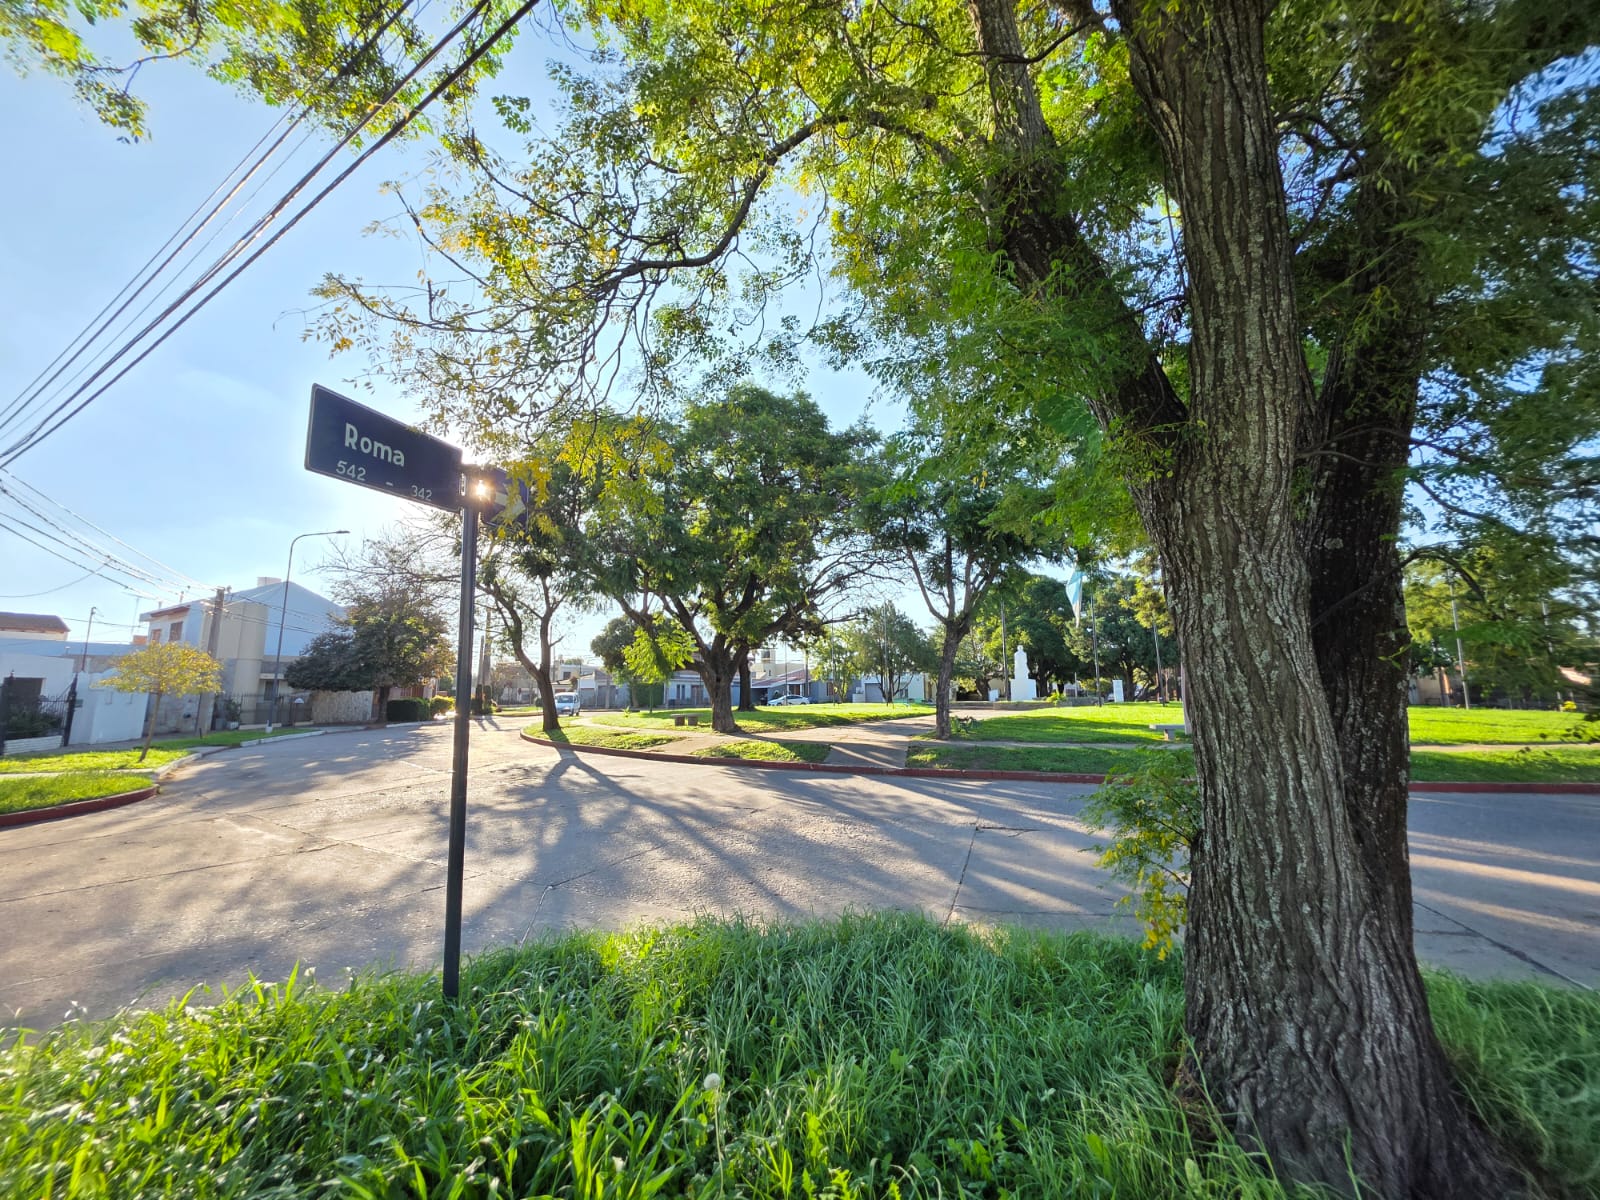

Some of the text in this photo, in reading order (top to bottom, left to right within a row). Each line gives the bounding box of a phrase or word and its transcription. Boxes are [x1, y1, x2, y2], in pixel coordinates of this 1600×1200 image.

[344, 422, 405, 467] Roma
[336, 460, 366, 481] 542
[411, 485, 433, 501] 342
